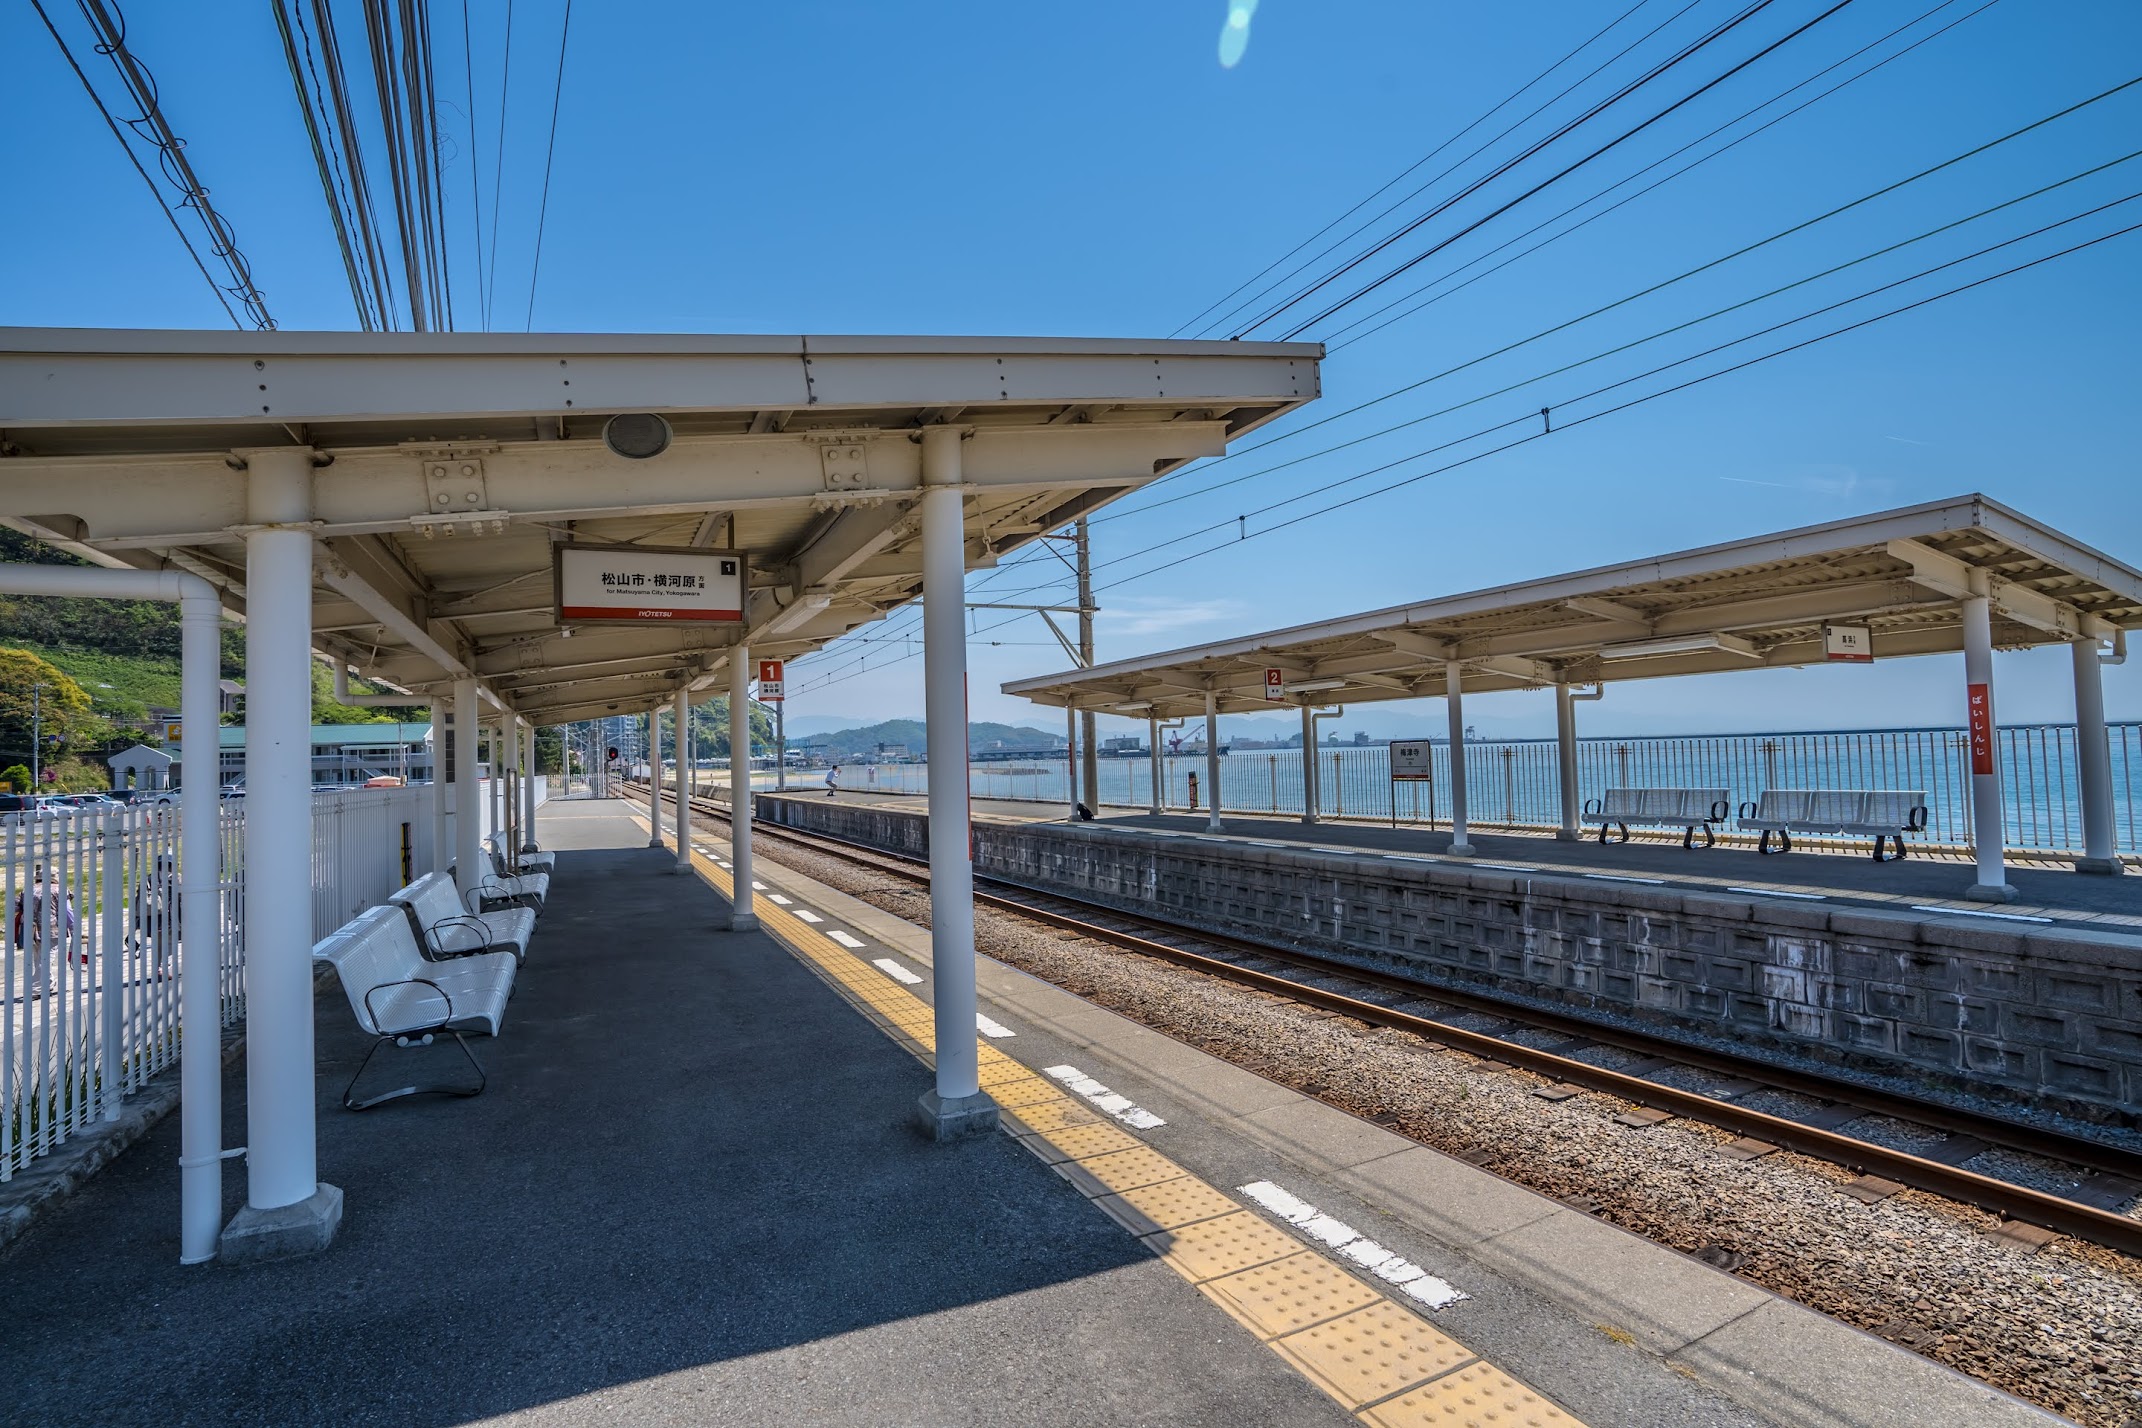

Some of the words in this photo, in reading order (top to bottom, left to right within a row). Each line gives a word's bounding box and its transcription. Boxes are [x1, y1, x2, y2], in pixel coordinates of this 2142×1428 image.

[726, 564, 731, 572] 1
[638, 610, 673, 618] IYOTETSU
[766, 664, 775, 679] 1
[1270, 672, 1279, 684] 2
[1972, 695, 1985, 756] ばいしんじ
